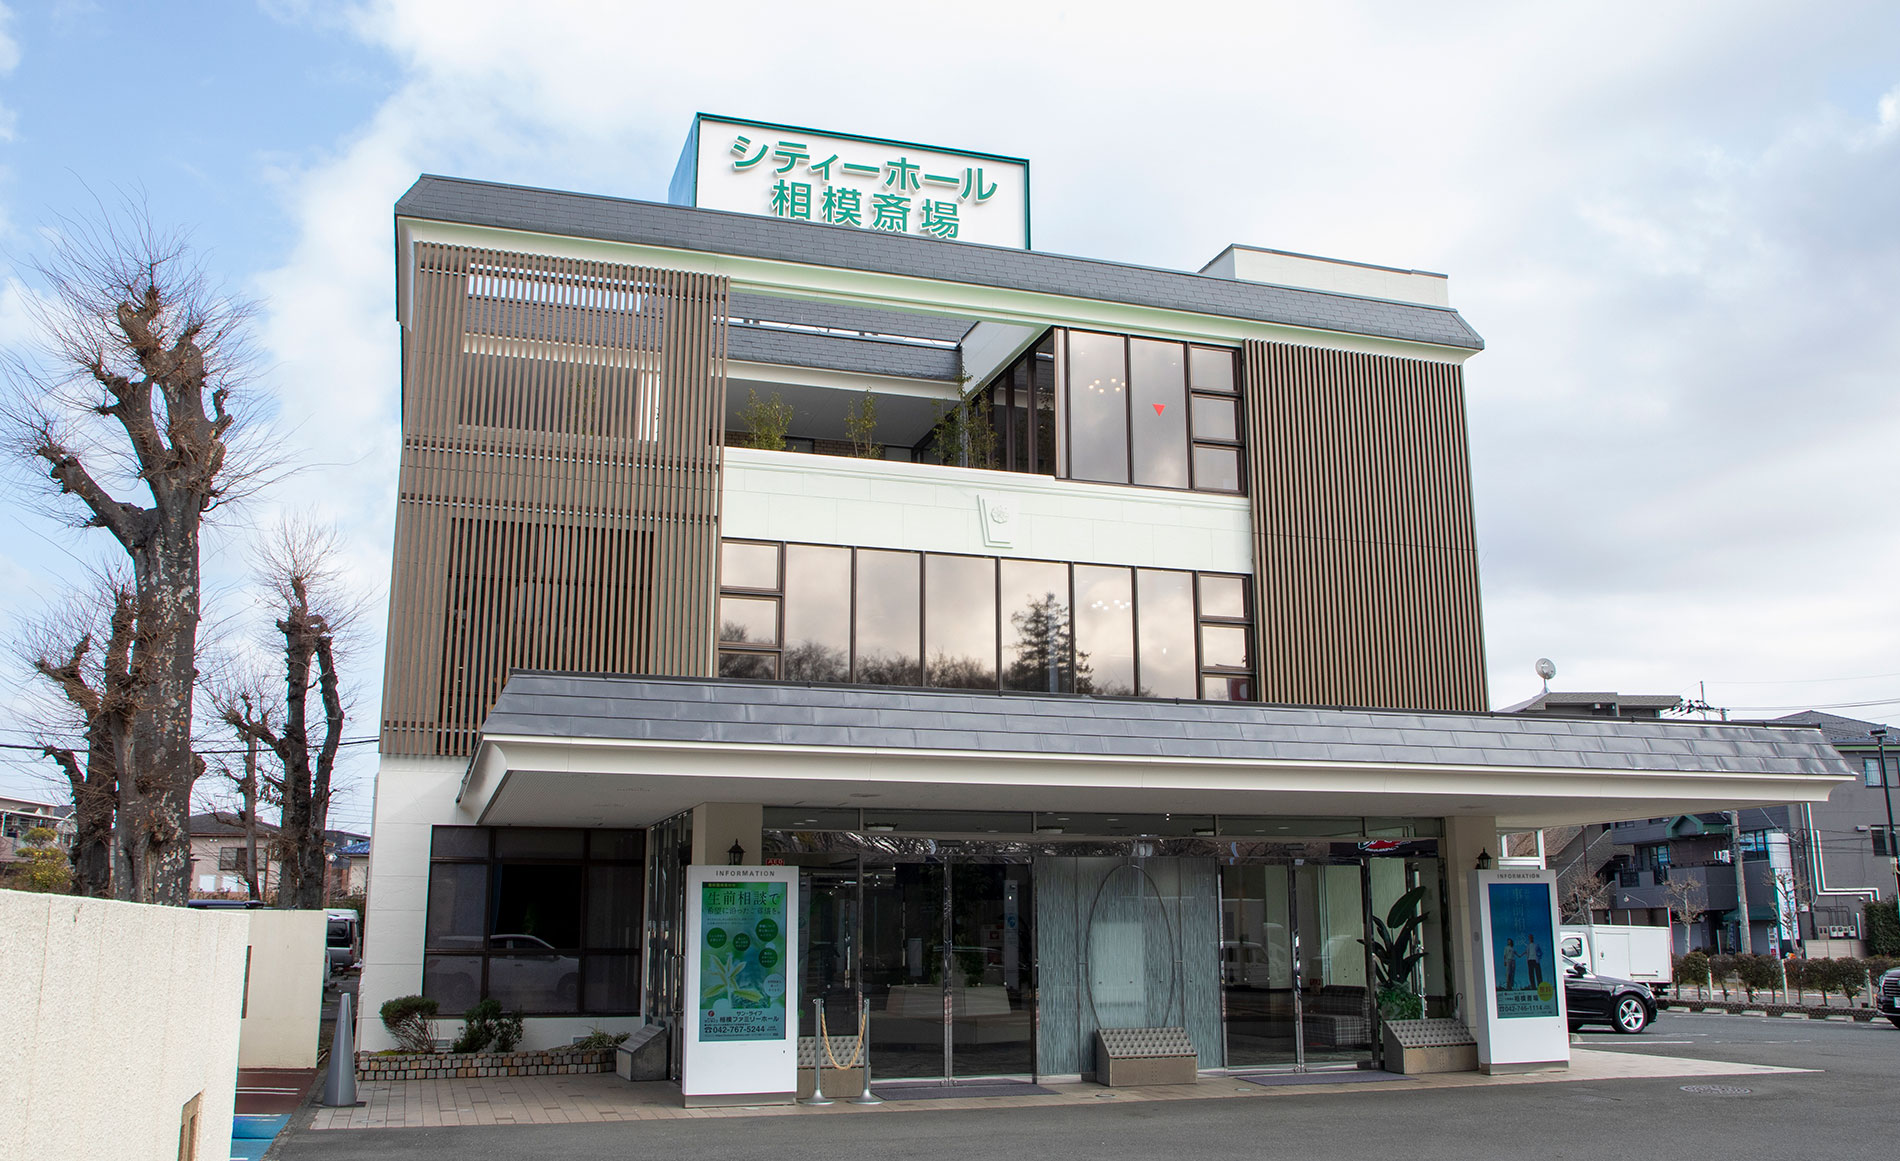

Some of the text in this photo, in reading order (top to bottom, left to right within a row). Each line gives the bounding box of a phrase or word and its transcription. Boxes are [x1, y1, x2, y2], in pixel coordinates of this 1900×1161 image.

[730, 135, 998, 203] シティーホール
[771, 178, 961, 240] 相模斎場
[707, 890, 781, 906] 生前相談で
[713, 1025, 765, 1034] 042-767-5244
